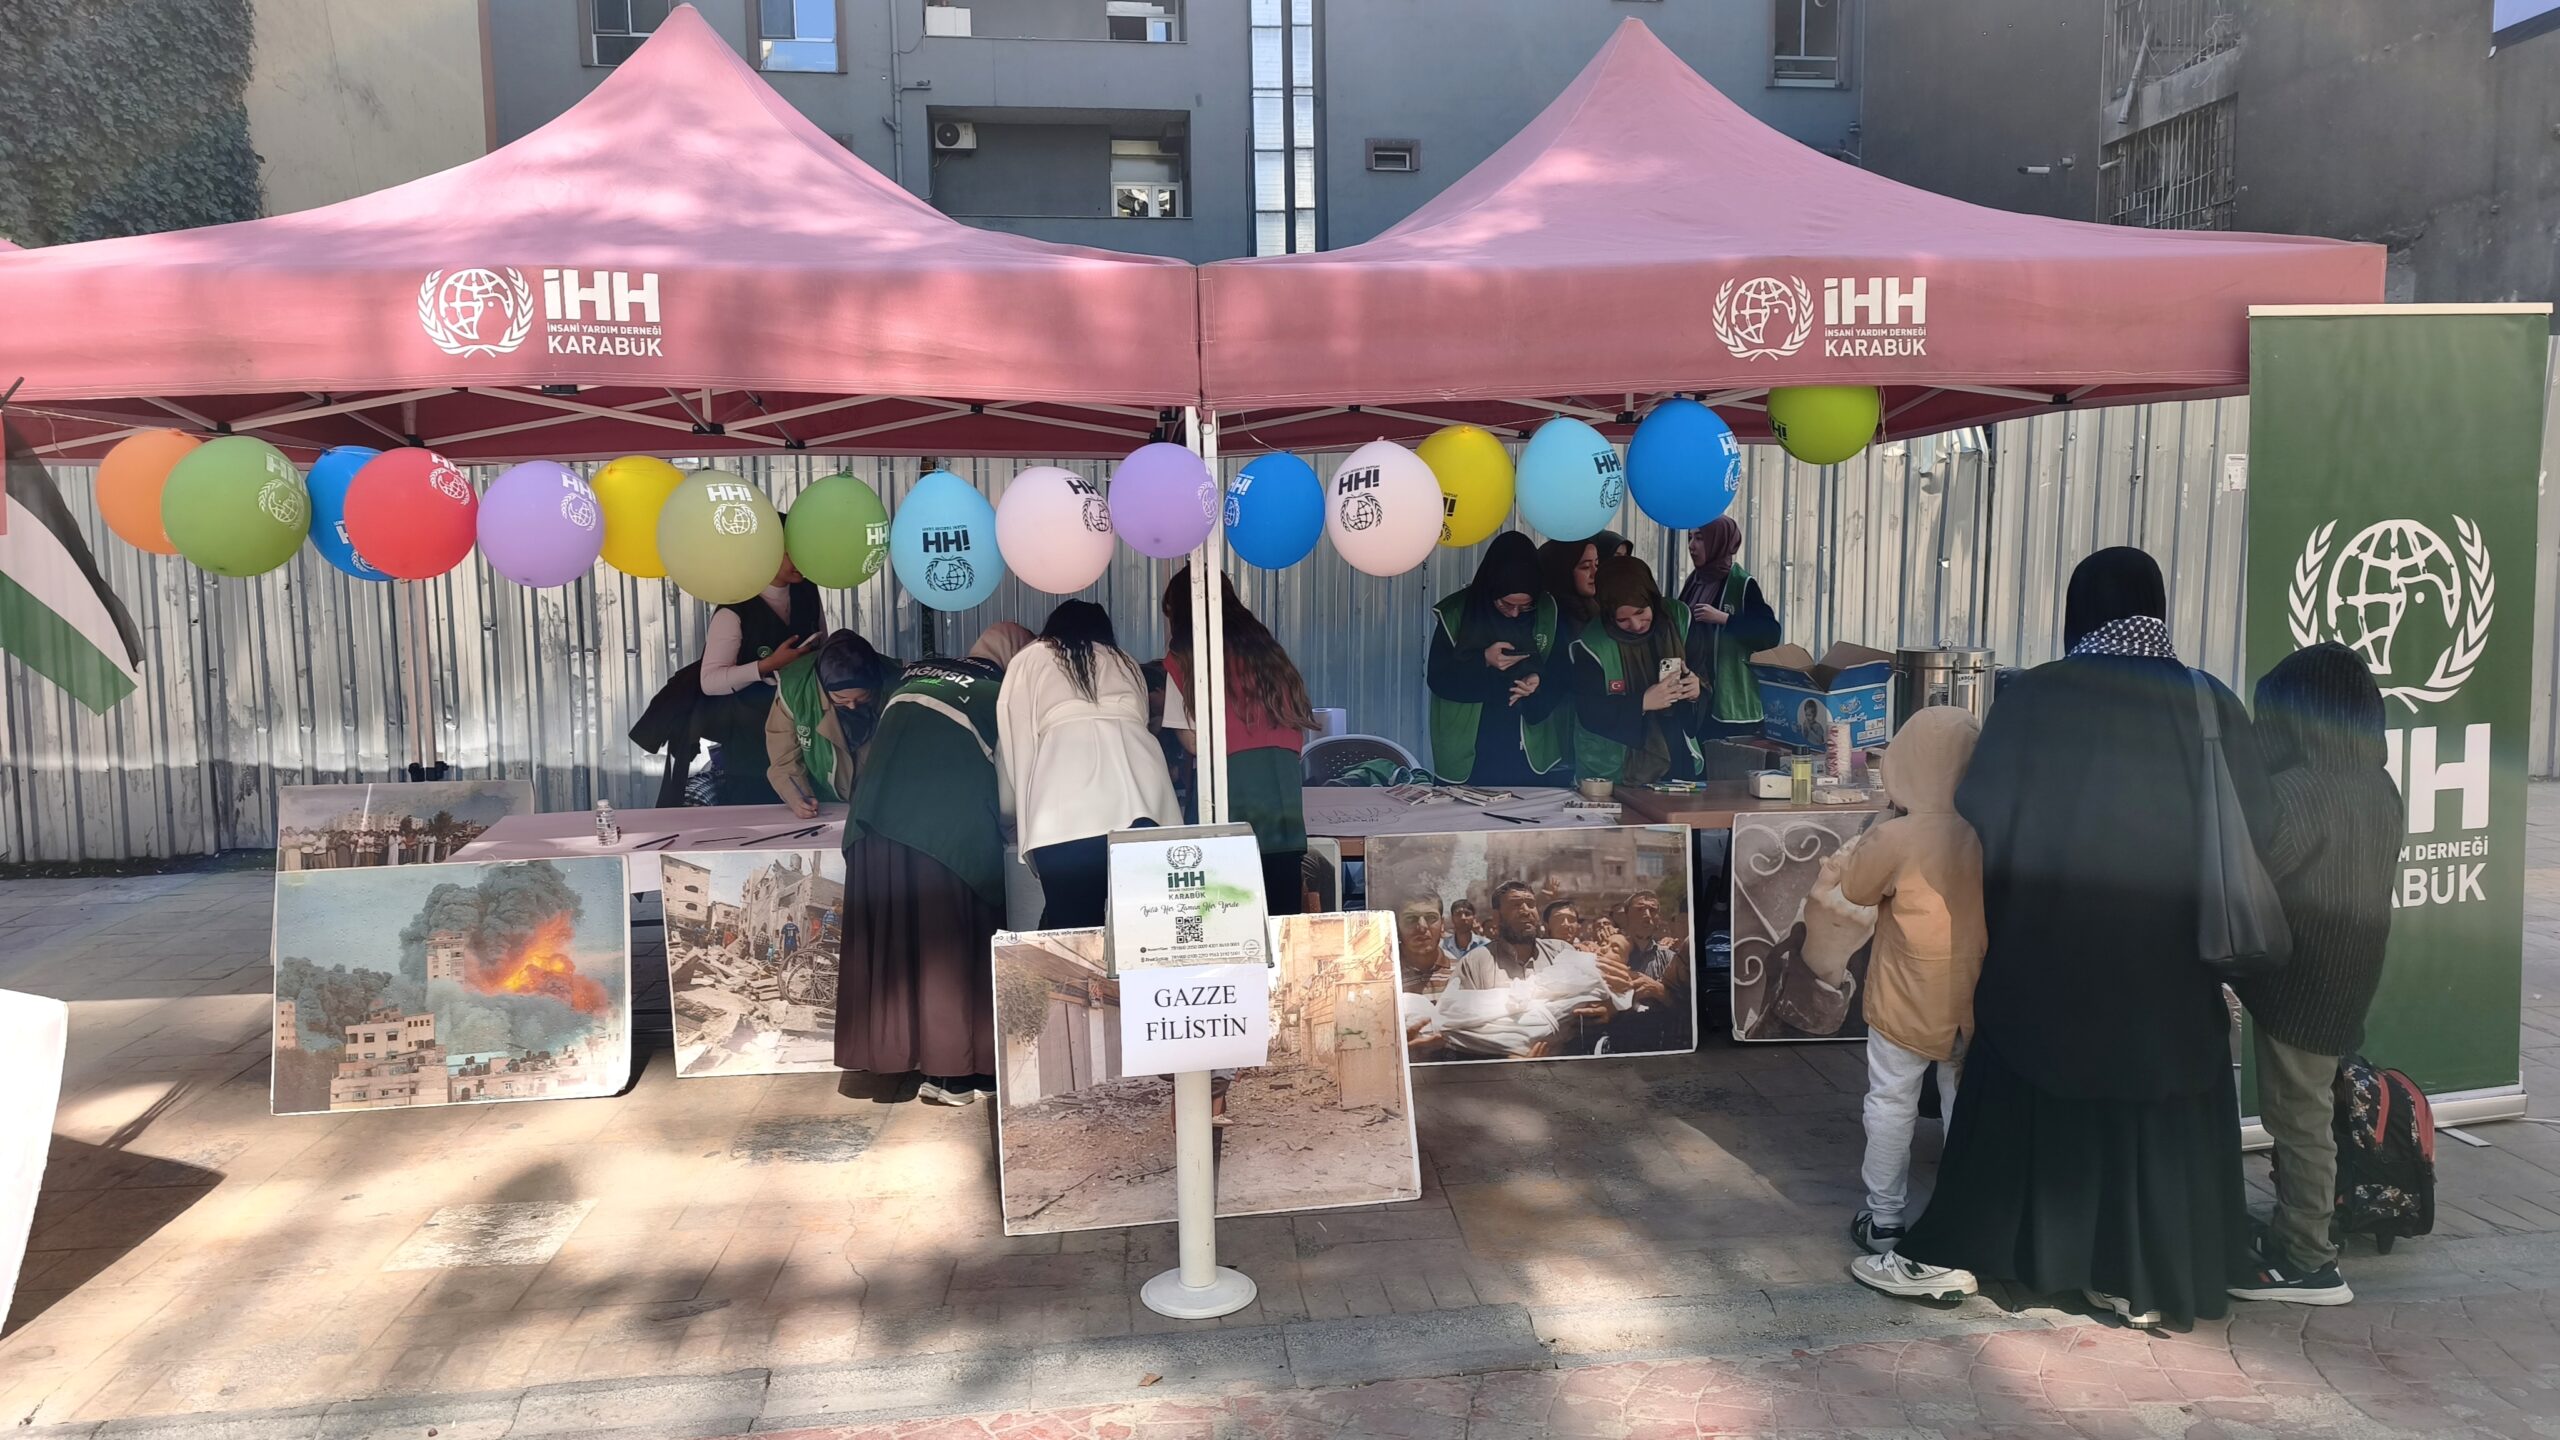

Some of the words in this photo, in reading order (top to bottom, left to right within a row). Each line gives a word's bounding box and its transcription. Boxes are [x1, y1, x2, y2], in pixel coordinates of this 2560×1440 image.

[547, 322, 580, 334] İNSANİ
[581, 324, 618, 335] YARDIM
[620, 325, 662, 336] DERNEĞİ
[1824, 327, 1854, 337] İNSANİ
[1855, 328, 1888, 337] YARDIM
[1889, 326, 1927, 337] DERNEĞİ
[548, 335, 663, 357] KARABÜK
[1825, 338, 1927, 357] KARABÜK
[2416, 835, 2489, 861] DERNEĞİ
[1169, 891, 1206, 900] KARABÜK
[1154, 985, 1237, 1008] GAZZE
[1145, 1013, 1248, 1041] FİLİSTİN
